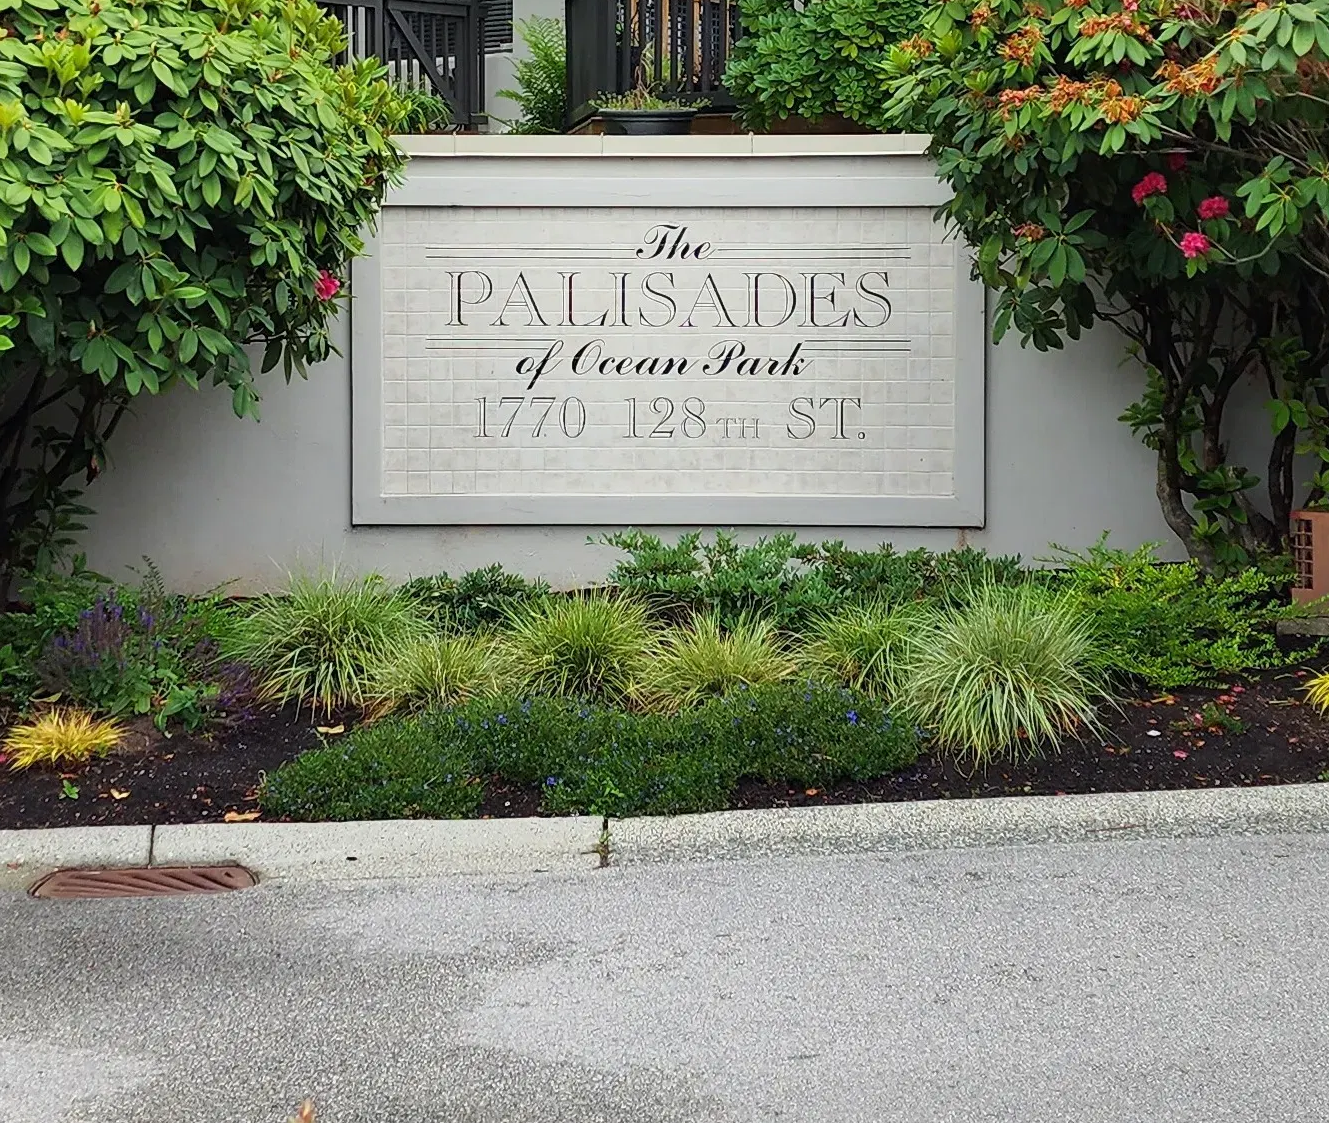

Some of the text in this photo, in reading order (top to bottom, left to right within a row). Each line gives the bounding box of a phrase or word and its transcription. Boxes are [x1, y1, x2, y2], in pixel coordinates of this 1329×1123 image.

[635, 224, 714, 261] The
[445, 270, 893, 328] PALISADES
[515, 339, 813, 389] of Ocean Park
[472, 396, 587, 438] 1770
[787, 396, 866, 440] ST.
